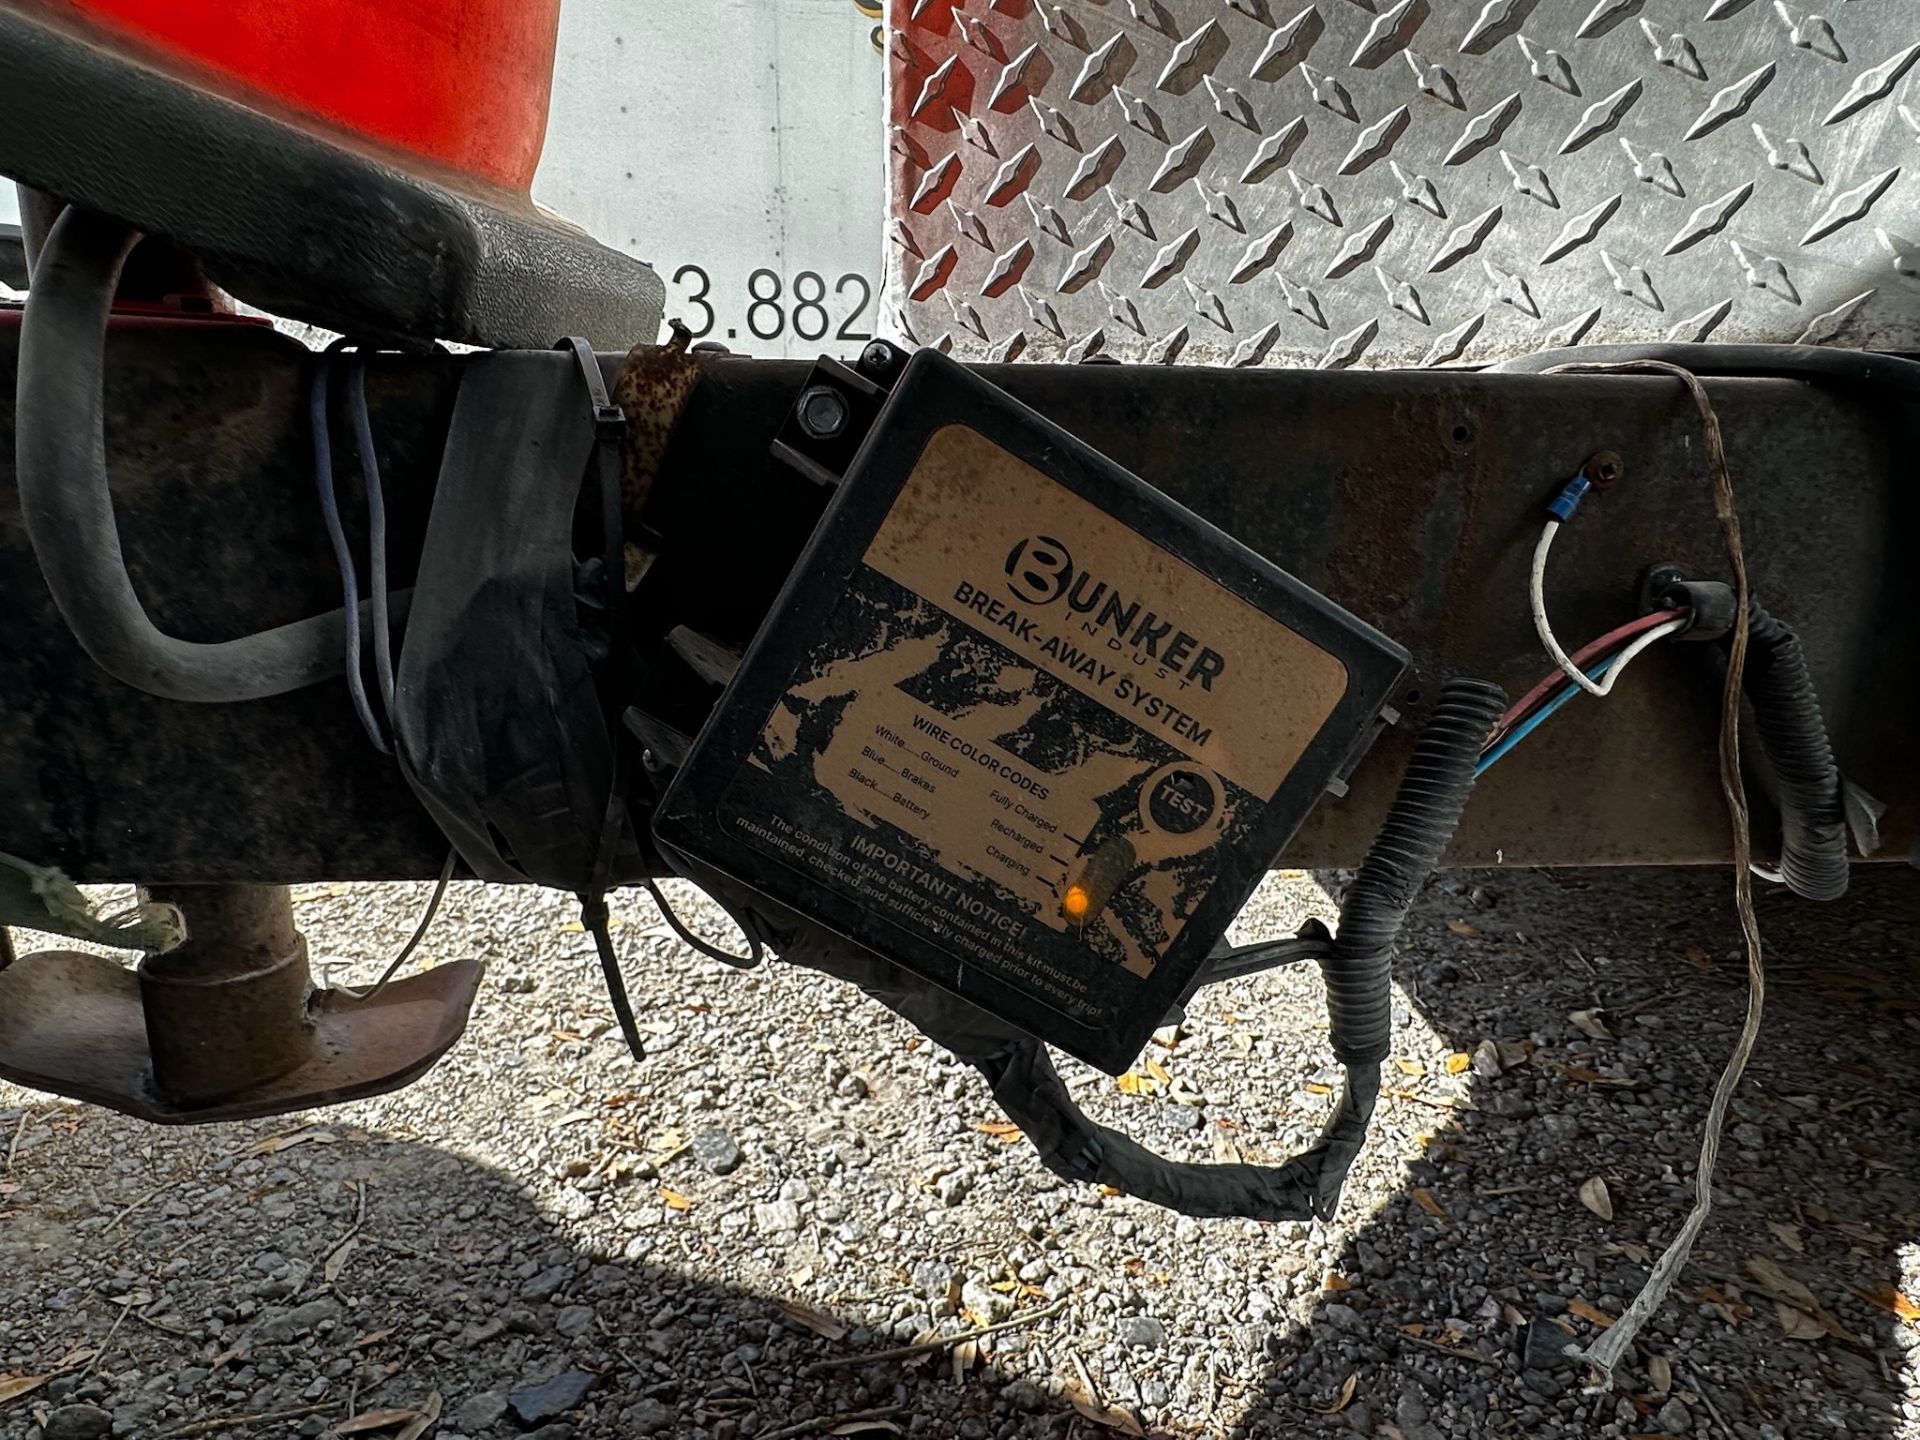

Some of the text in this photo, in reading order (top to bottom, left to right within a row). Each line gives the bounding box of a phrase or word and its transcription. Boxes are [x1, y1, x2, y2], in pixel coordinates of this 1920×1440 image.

[661, 264, 872, 341] 3.882
[1004, 535, 1230, 693] BUNKER
[1064, 610, 1191, 694] INDUST
[952, 580, 1213, 749] BREAK-AWAY SYSTEM
[910, 714, 1050, 802] WIRE COLOR CODES
[988, 789, 1058, 836] Fully Charged
[989, 817, 1045, 857] Recharged
[1156, 783, 1208, 823] TEST
[769, 814, 795, 835] The
[793, 827, 853, 867] condition
[864, 866, 889, 886] the
[887, 878, 932, 912] battery
[930, 902, 991, 942] contained
[1002, 941, 1027, 961] this
[1024, 953, 1044, 970] kit
[849, 833, 1028, 941] IMPORTANT NOTICE!
[984, 844, 1032, 879] Charging
[862, 882, 888, 903] and
[952, 932, 1003, 968] charged
[1000, 958, 1032, 981] prior
